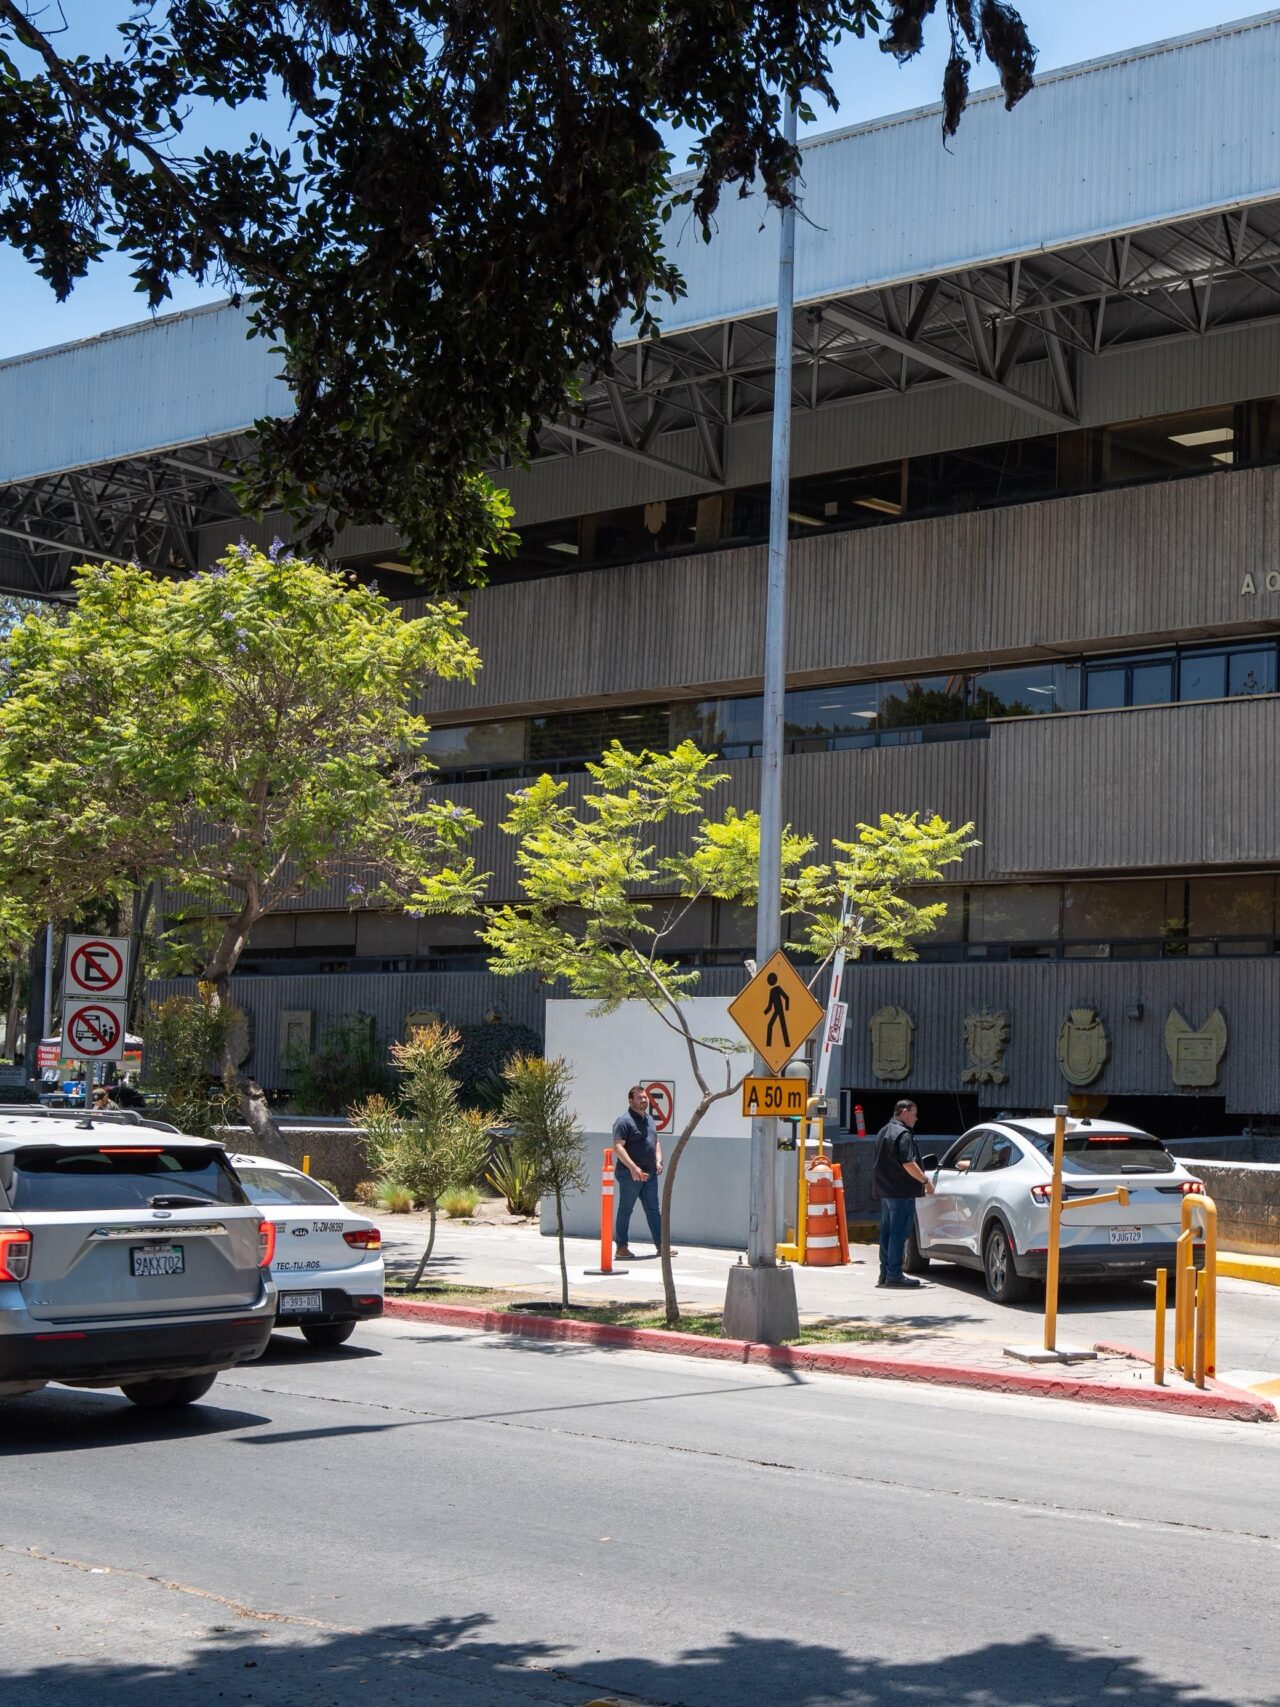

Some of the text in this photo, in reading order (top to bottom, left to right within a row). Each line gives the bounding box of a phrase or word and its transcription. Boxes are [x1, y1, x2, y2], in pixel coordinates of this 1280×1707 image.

[84, 950, 110, 983] E
[747, 1085, 802, 1108] A 50 m
[1111, 1232, 1142, 1242] 9JUG729
[135, 1255, 181, 1272] 9AKX702
[135, 1267, 174, 1276] PERRY
